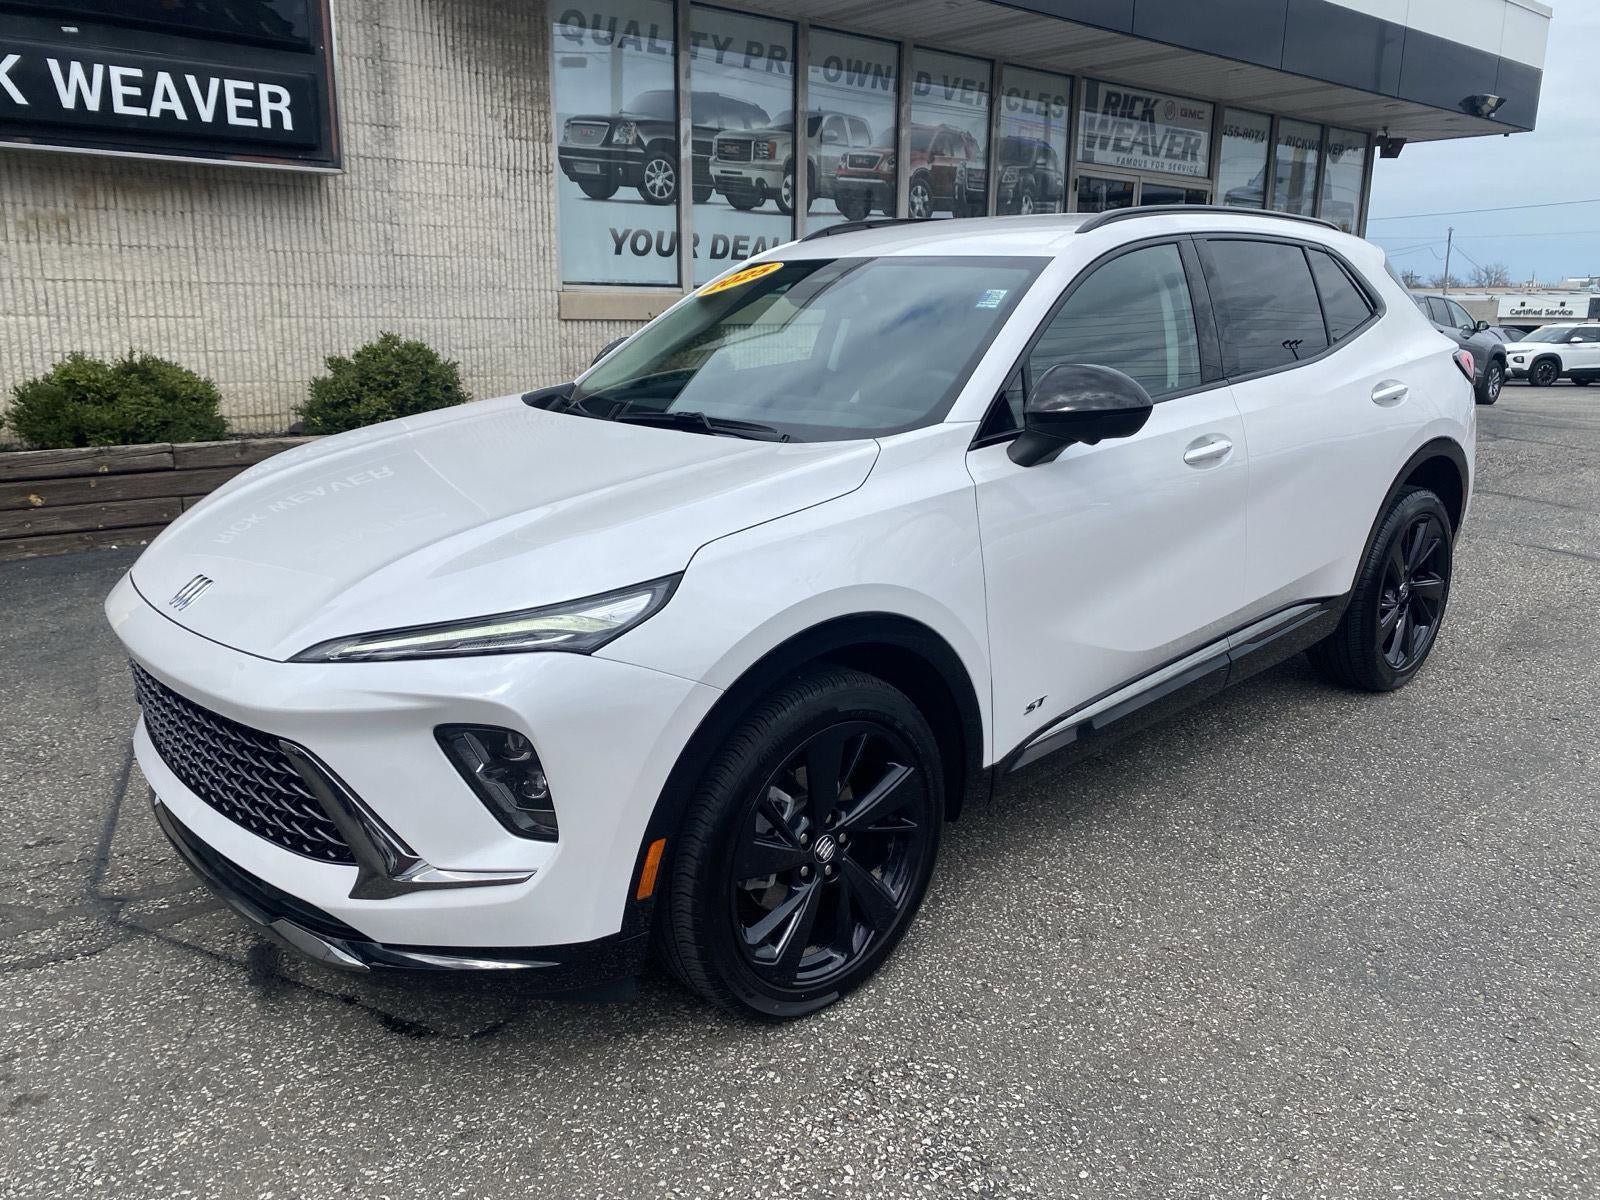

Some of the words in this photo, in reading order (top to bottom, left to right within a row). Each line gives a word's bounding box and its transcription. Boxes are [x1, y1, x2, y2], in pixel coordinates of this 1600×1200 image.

[559, 9, 734, 64] QUALTY
[46, 57, 294, 131] WEAVER
[1103, 91, 1160, 123] RICK
[1179, 107, 1205, 120] GMC
[1085, 115, 1203, 161] WEAVER
[1116, 157, 1148, 168] FAMOUS
[1151, 160, 1165, 170] FOR
[1169, 162, 1199, 174] SERVICE
[1509, 308, 1542, 316] Certified
[1545, 308, 1573, 316] Service
[1024, 695, 1048, 716] ST
